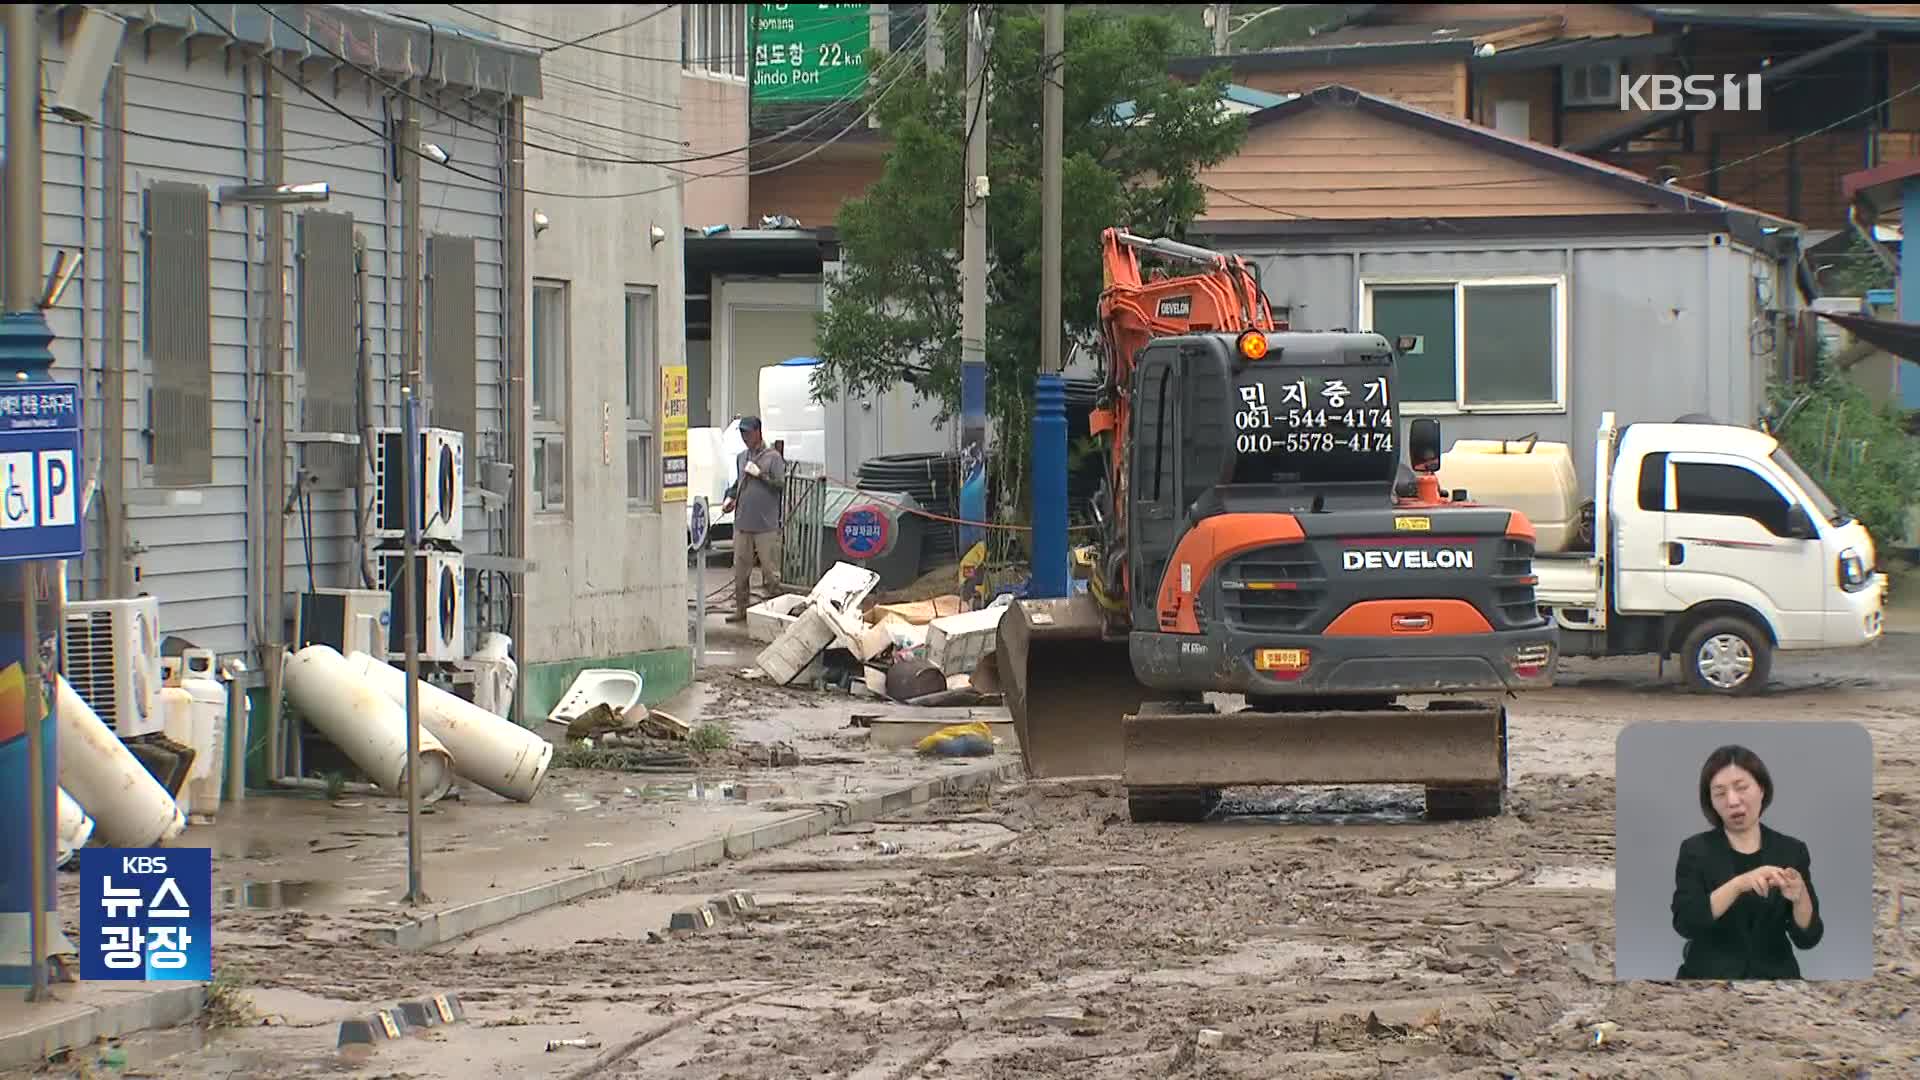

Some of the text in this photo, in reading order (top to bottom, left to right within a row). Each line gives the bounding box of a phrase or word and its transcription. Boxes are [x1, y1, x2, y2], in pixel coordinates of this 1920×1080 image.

[754, 69, 819, 86] Jindo Port
[22, 393, 38, 415] 전용
[40, 392, 74, 415] 주차구역
[1235, 408, 1392, 430] 061-544-4174
[1236, 432, 1392, 452] 010-5578-4174
[48, 458, 67, 519] P
[845, 525, 880, 537] 주정차금지
[1343, 549, 1473, 570] DEVELON
